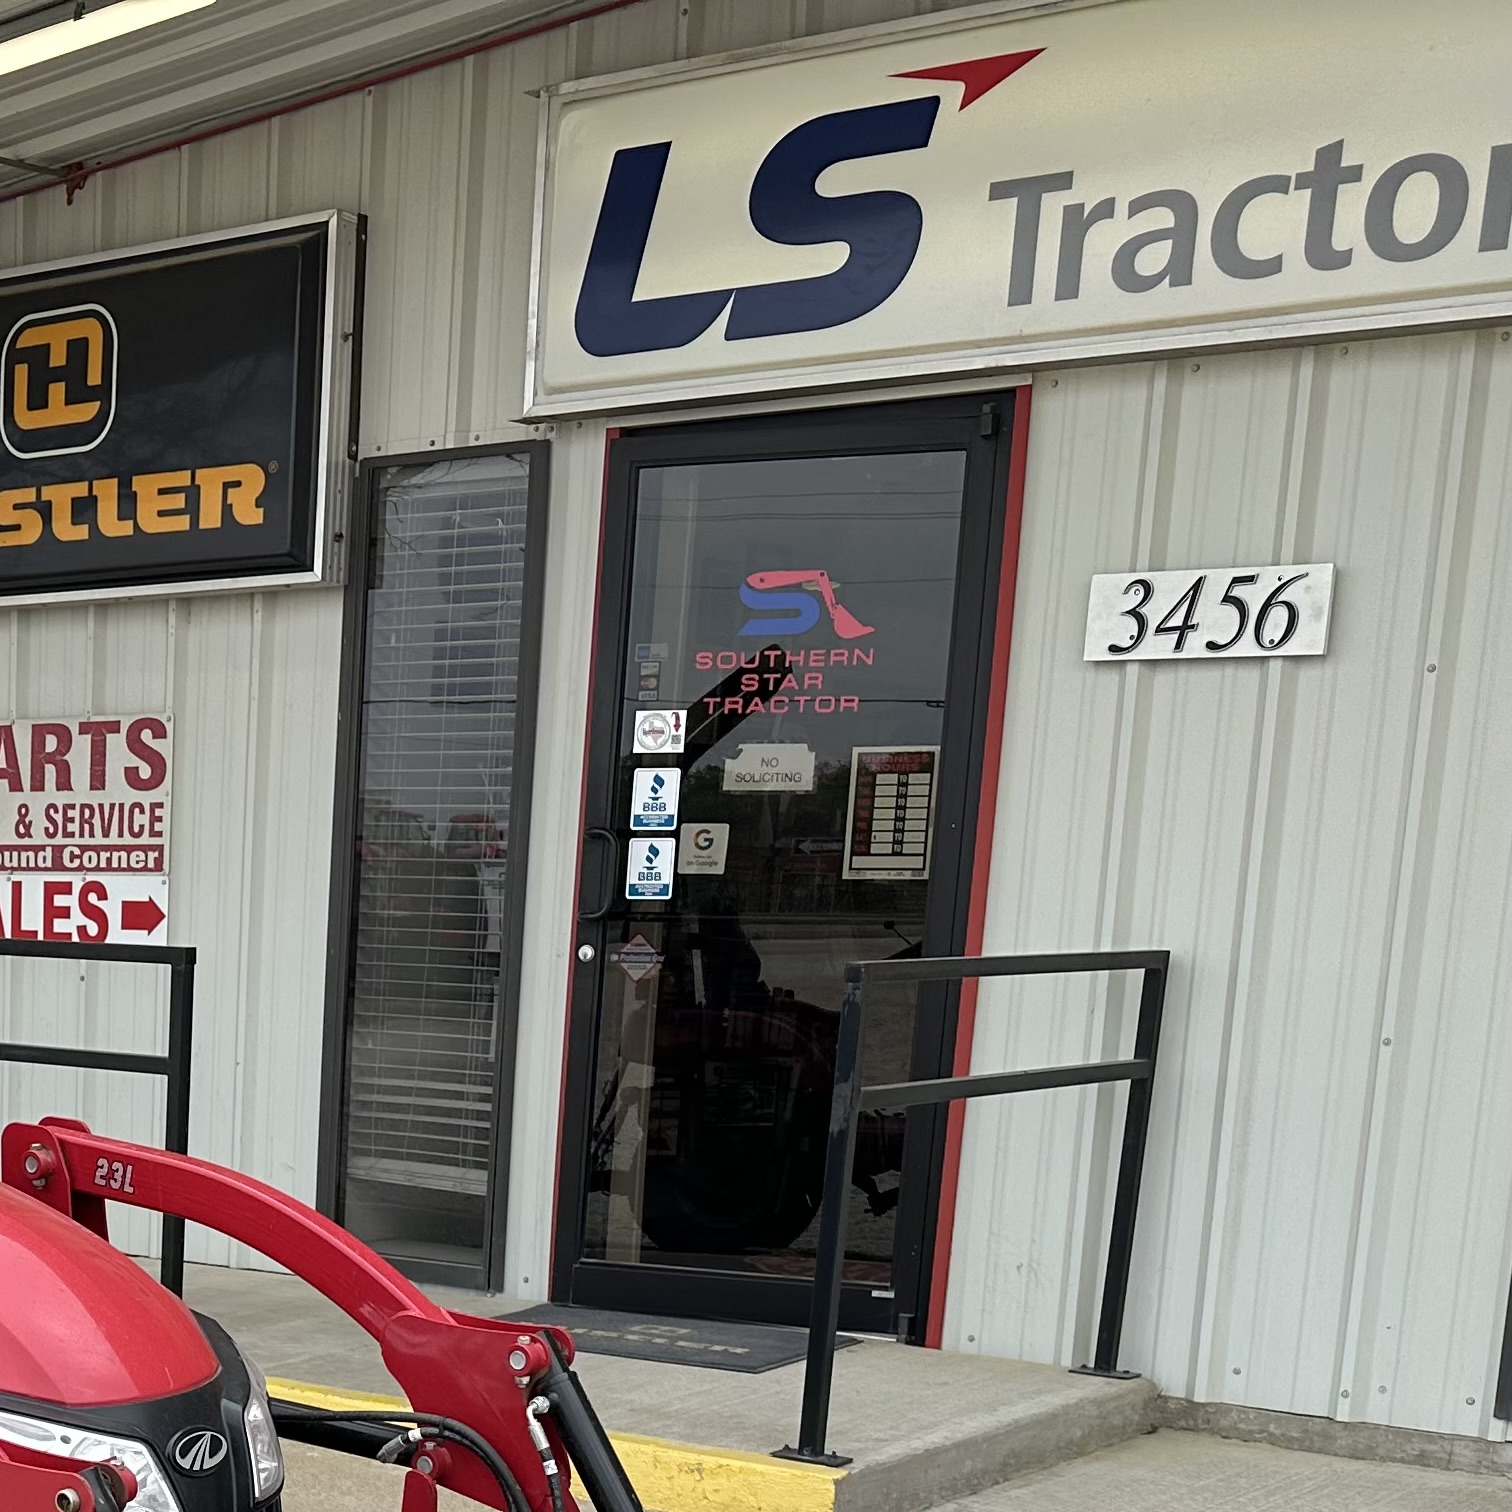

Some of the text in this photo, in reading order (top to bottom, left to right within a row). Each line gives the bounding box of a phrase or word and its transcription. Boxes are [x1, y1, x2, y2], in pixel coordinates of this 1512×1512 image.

[574, 94, 941, 357] LS
[1107, 570, 1311, 656] 3456
[695, 648, 875, 669] SOUTHERN
[740, 672, 823, 692] STAR
[703, 696, 860, 715] TRACTOR
[760, 757, 779, 768] NO
[861, 754, 929, 764] BUSINESS
[872, 763, 920, 771] HOURS
[734, 772, 803, 784] SOLICITING
[642, 802, 667, 812] BBB
[14, 802, 164, 839] & SERVICE
[62, 846, 159, 869] Corner
[695, 858, 718, 868] Google
[637, 872, 662, 881] BBB
[94, 1157, 134, 1193] 23L
